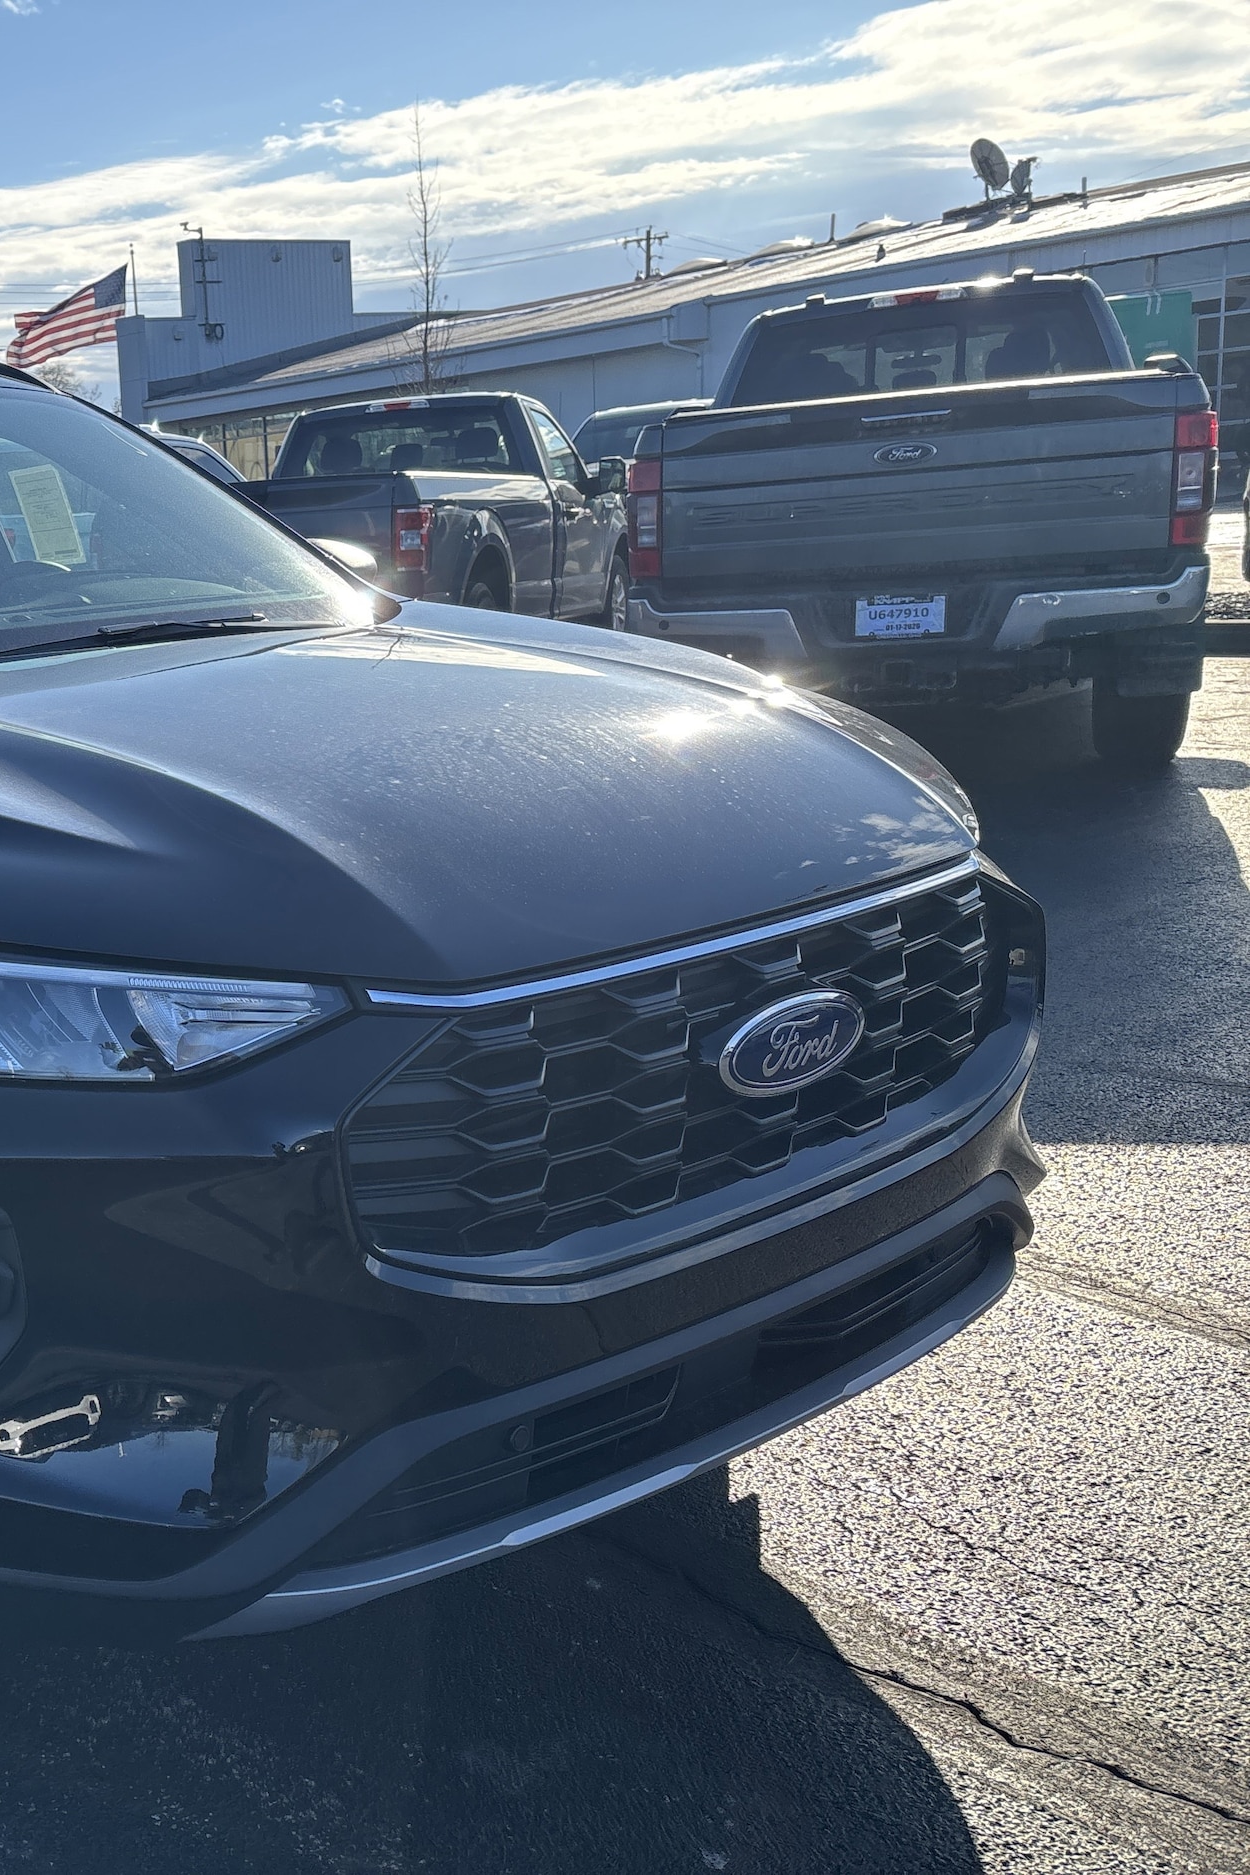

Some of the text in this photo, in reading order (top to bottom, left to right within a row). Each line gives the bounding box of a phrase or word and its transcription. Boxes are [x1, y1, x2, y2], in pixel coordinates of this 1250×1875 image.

[888, 446, 922, 461] Ford
[868, 607, 930, 620] U647910
[762, 1014, 840, 1078] Ford
